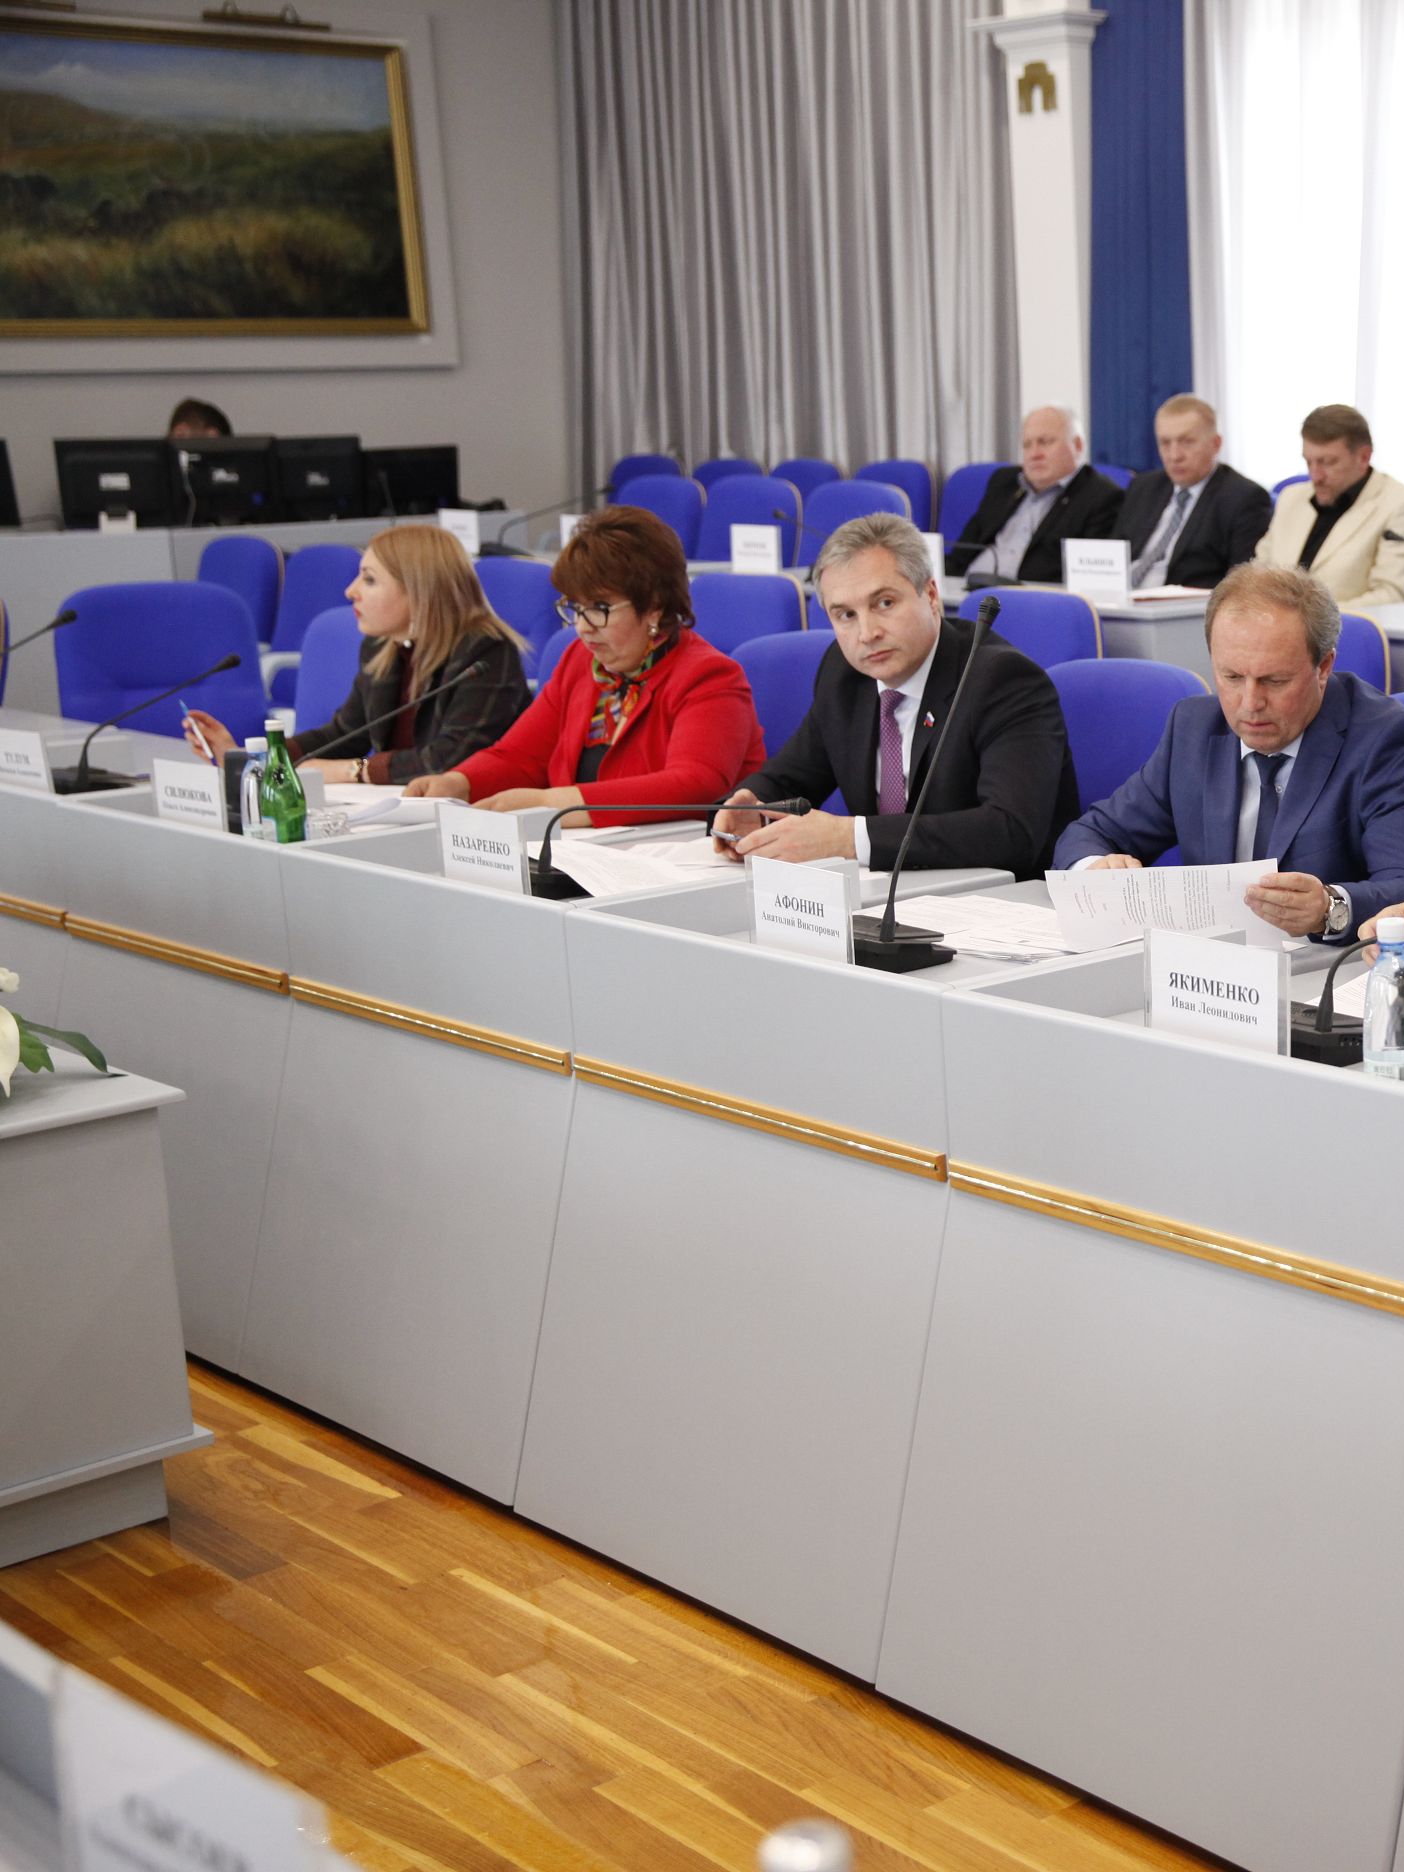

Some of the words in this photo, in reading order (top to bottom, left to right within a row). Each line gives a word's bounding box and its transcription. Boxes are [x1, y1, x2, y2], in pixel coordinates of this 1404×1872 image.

[452, 834, 511, 857] НАЗАРЕНКО
[452, 852, 476, 865] Алексей
[476, 855, 514, 872] Николаевич
[774, 893, 825, 918] АФОНИН
[761, 911, 796, 928] Анатолий
[797, 918, 840, 938] Викторович
[1169, 972, 1260, 1006] ЯКИМЕНКО
[1171, 995, 1196, 1012] Иван
[1198, 1001, 1258, 1025] Леонидович
